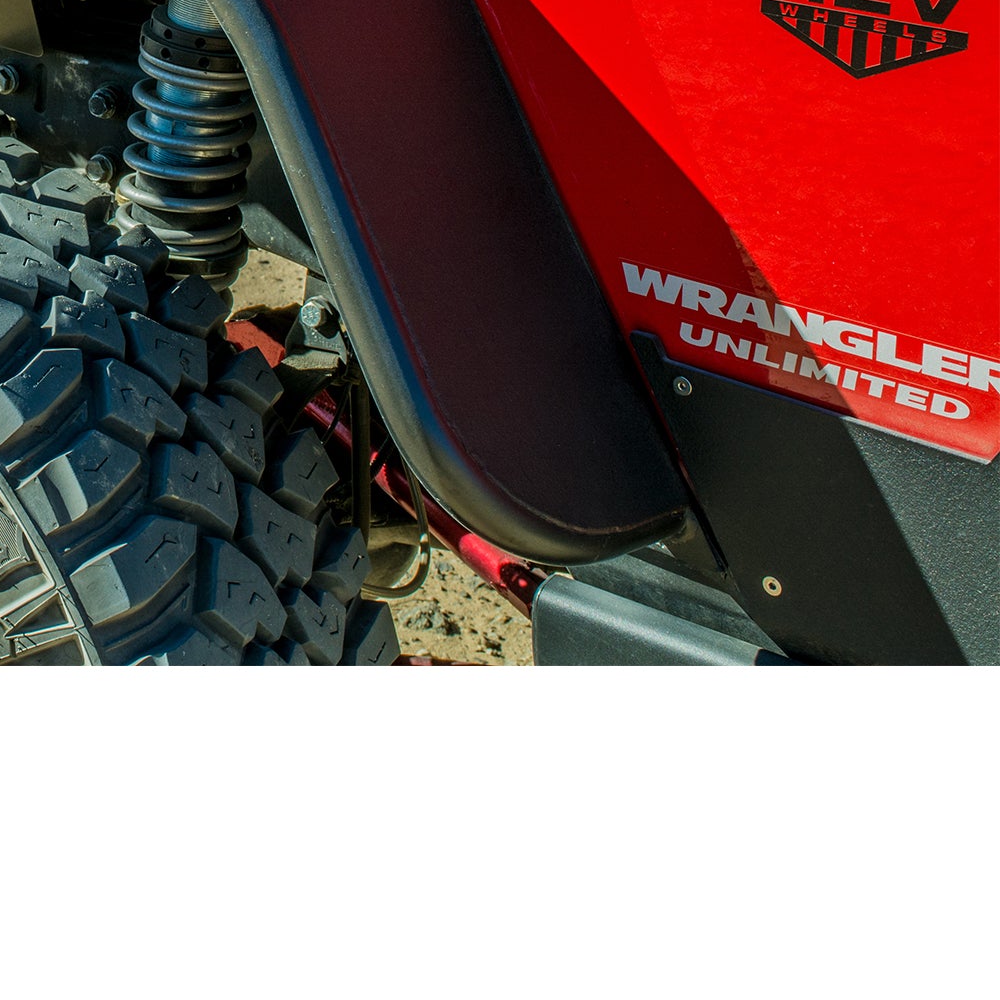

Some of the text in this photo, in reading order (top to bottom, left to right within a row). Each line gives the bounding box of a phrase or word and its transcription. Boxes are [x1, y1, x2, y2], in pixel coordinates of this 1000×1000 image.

[778, 2, 948, 45] WHEELS
[621, 261, 1000, 392] WRANGLER
[678, 321, 971, 420] UNLIMITED
